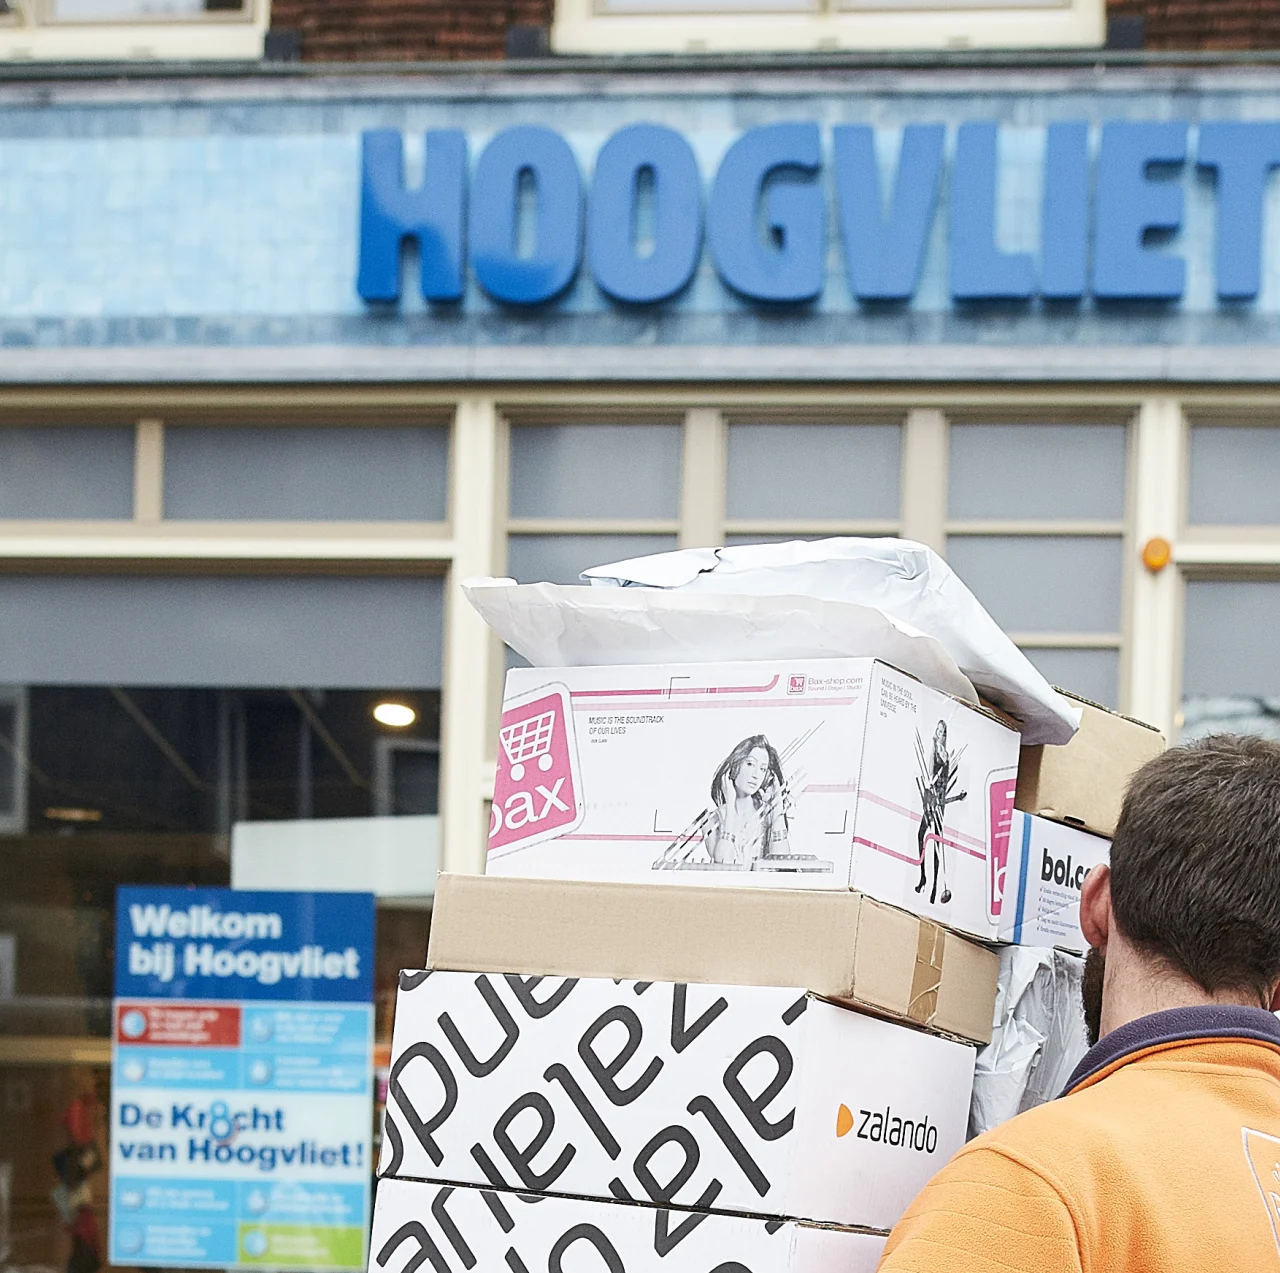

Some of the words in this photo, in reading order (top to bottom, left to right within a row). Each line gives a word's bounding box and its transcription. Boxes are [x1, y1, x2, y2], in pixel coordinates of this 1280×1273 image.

[808, 677, 863, 685] Bax-shop.com
[589, 716, 607, 724] MUSIC
[608, 716, 613, 724] IS
[614, 716, 625, 724] THE
[626, 715, 664, 724] SOUNDTRACK
[589, 727, 597, 735] OF
[598, 727, 610, 735] OUR
[611, 726, 626, 735] LIVES
[1041, 847, 1091, 891] bol.c
[129, 904, 282, 939] Welkom
[129, 944, 175, 982] bij
[184, 945, 360, 984] Hoogvliet
[119, 1103, 162, 1129] De
[857, 1106, 937, 1153] zalando
[119, 1142, 176, 1161] van
[188, 1139, 363, 1171] Hoogvliet!
